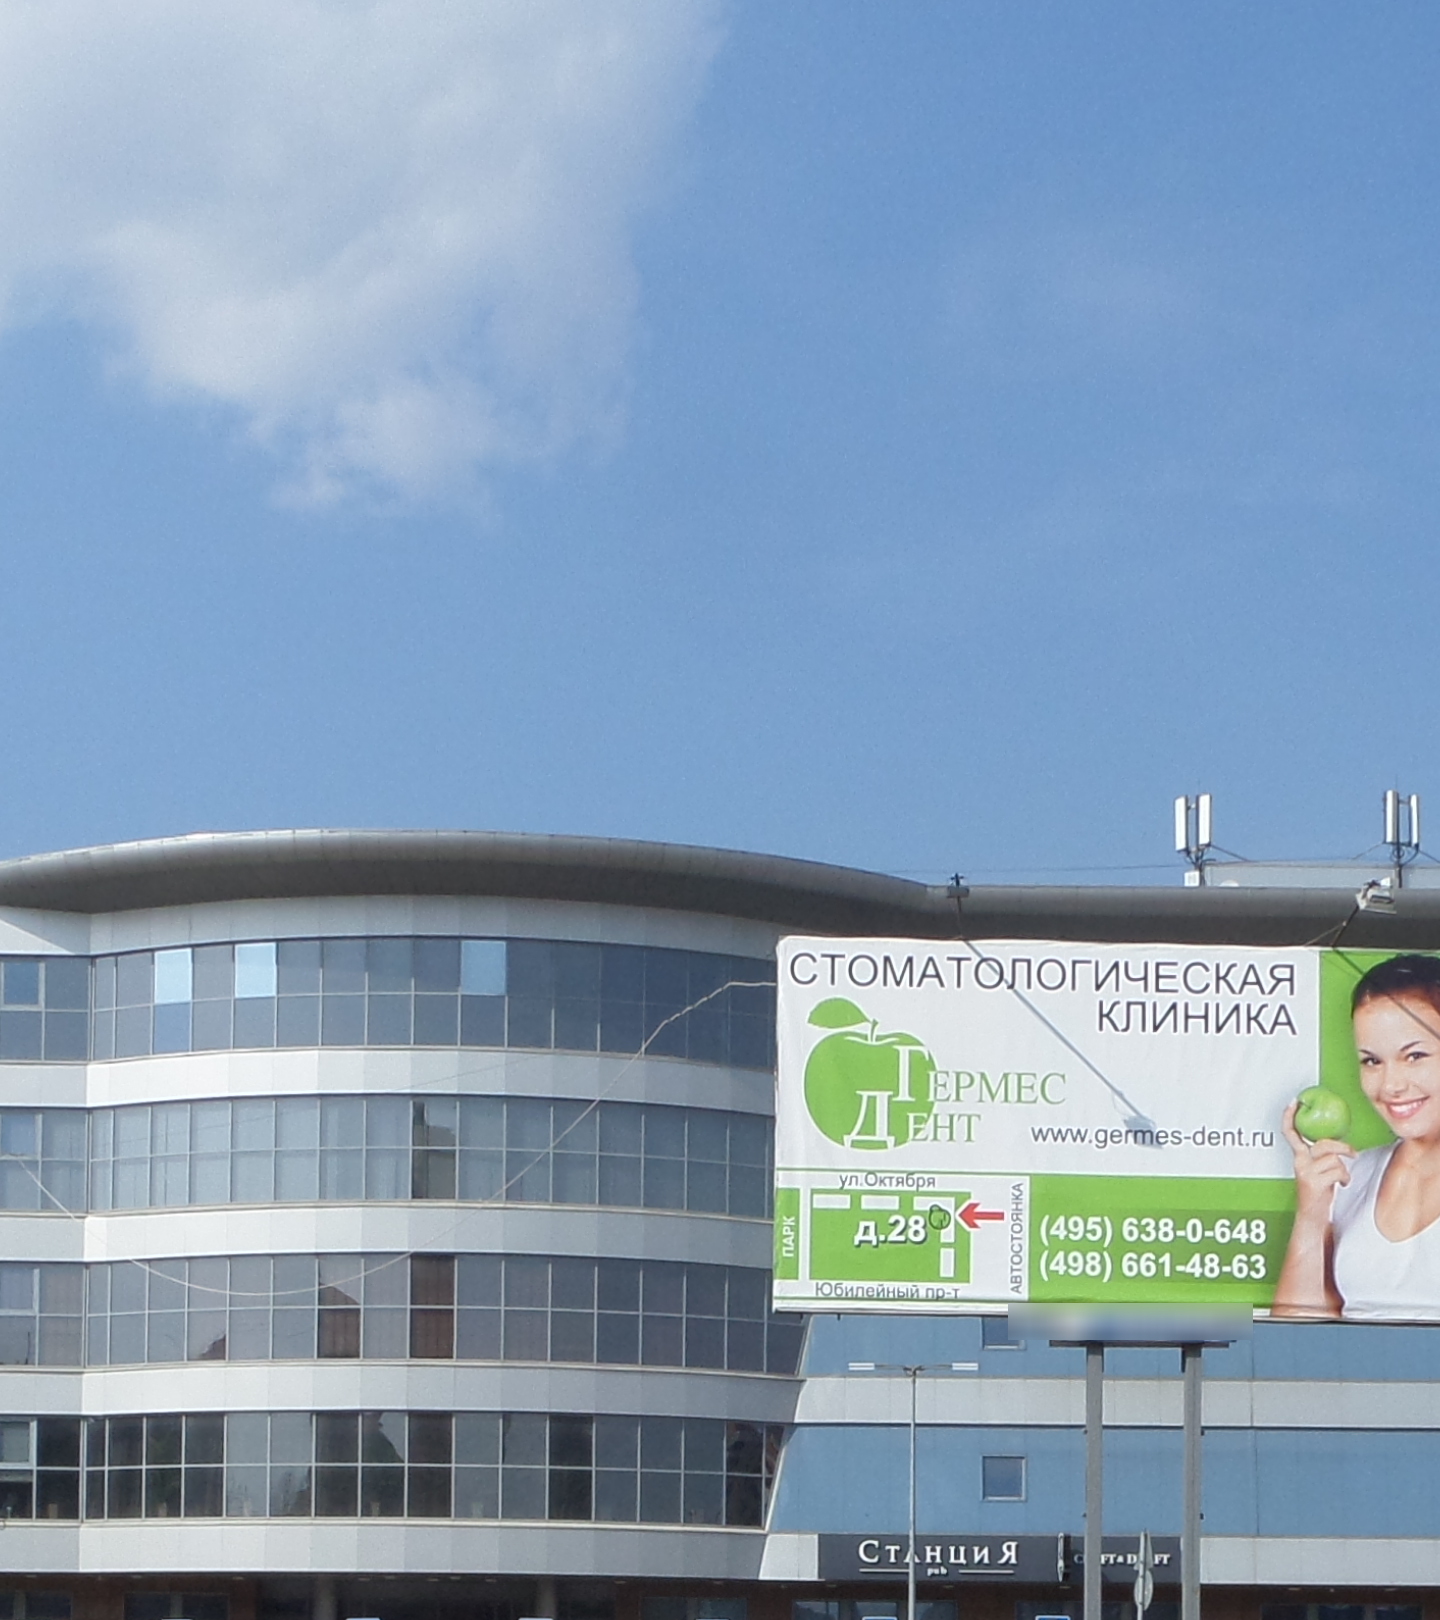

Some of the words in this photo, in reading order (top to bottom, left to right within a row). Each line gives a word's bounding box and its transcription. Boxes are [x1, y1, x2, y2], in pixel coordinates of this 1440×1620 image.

[789, 952, 1296, 997] СТОМАТОЛОГИЧЕСКАЯ
[1097, 1000, 1298, 1037] КЛИНИКА
[1031, 1126, 1274, 1149] www.germes-dent.ru
[782, 1216, 796, 1257] ПАРК
[854, 1214, 927, 1247] д.28
[1010, 1183, 1024, 1295] АВТОСТОЯНКА
[1040, 1214, 1112, 1247] (495)
[1122, 1217, 1266, 1244] 638-0-648
[1040, 1250, 1112, 1282] (498)
[1122, 1252, 1266, 1279] 661-48-63
[815, 1282, 920, 1299] Юбилейный
[925, 1285, 961, 1300] пр-т
